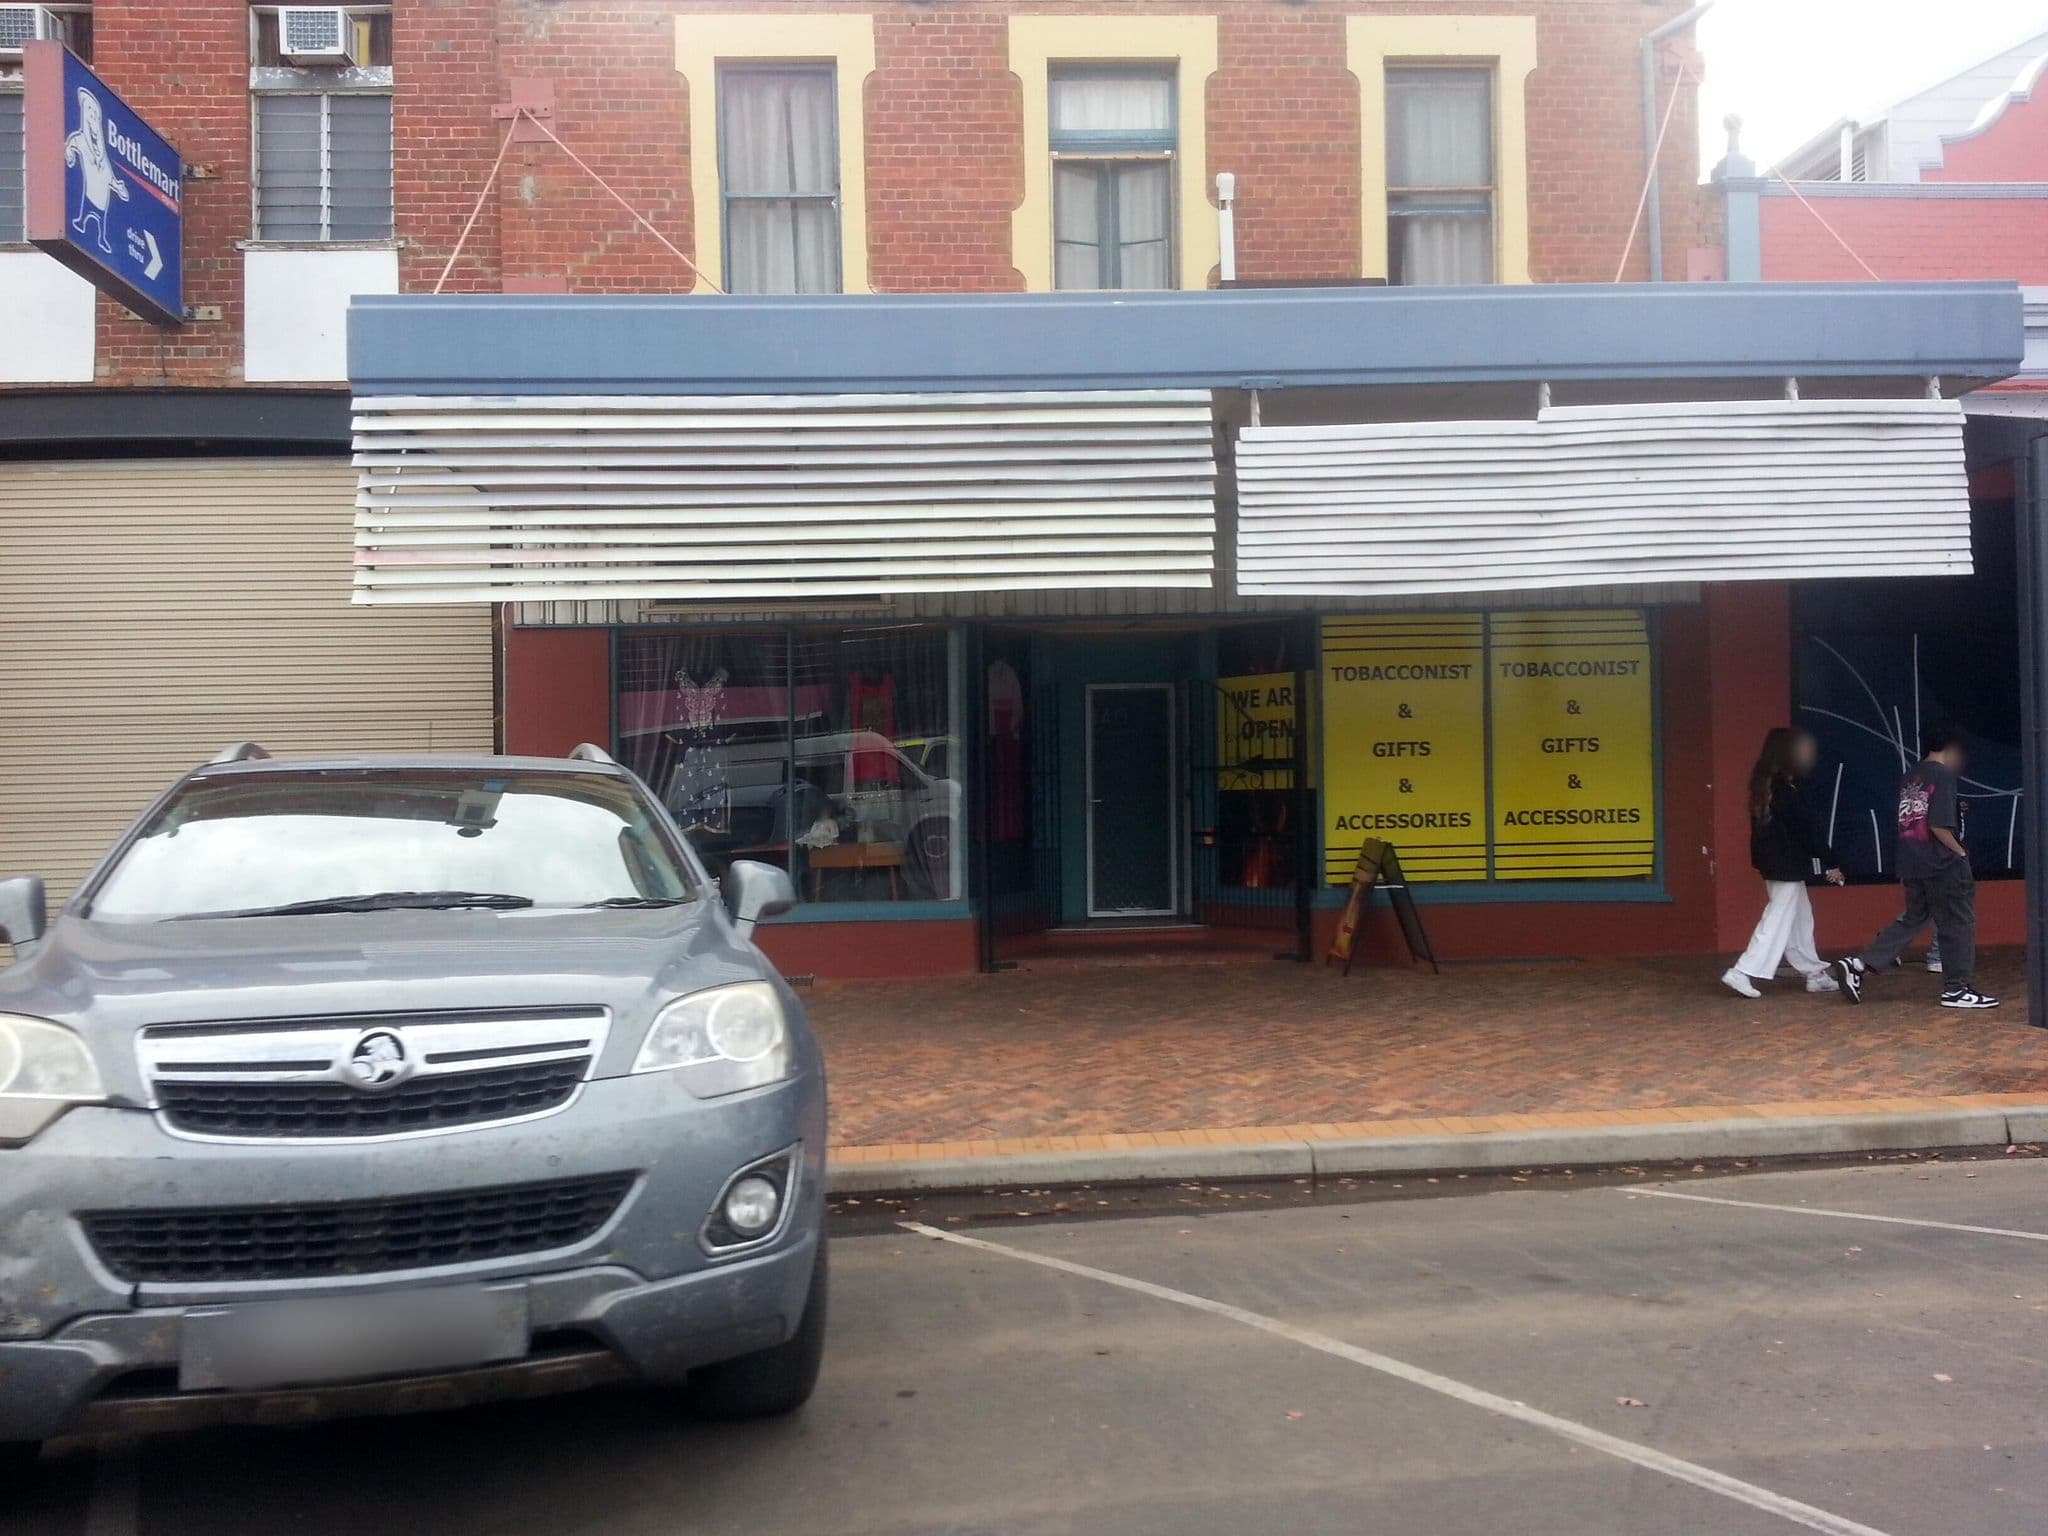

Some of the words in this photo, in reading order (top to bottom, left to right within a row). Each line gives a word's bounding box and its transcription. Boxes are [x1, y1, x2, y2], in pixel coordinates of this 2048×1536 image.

[108, 119, 179, 202] Bottlemart
[127, 227, 145, 250] drive
[128, 243, 145, 265] thru
[1331, 664, 1473, 681] TOBACCONIST
[1500, 660, 1640, 677] TOBACCONIST
[1230, 689, 1260, 709] WE
[1266, 687, 1295, 706] AR
[1398, 703, 1413, 718] &
[1567, 699, 1581, 715] &
[1242, 719, 1296, 740] OPEN
[1373, 741, 1431, 757] GIFTS
[1541, 737, 1600, 753] GIFTS
[1399, 778, 1413, 793] &
[1568, 774, 1582, 789] &
[1335, 812, 1472, 830] ACCESSORIES
[1504, 808, 1640, 826] ACCESSORIES
